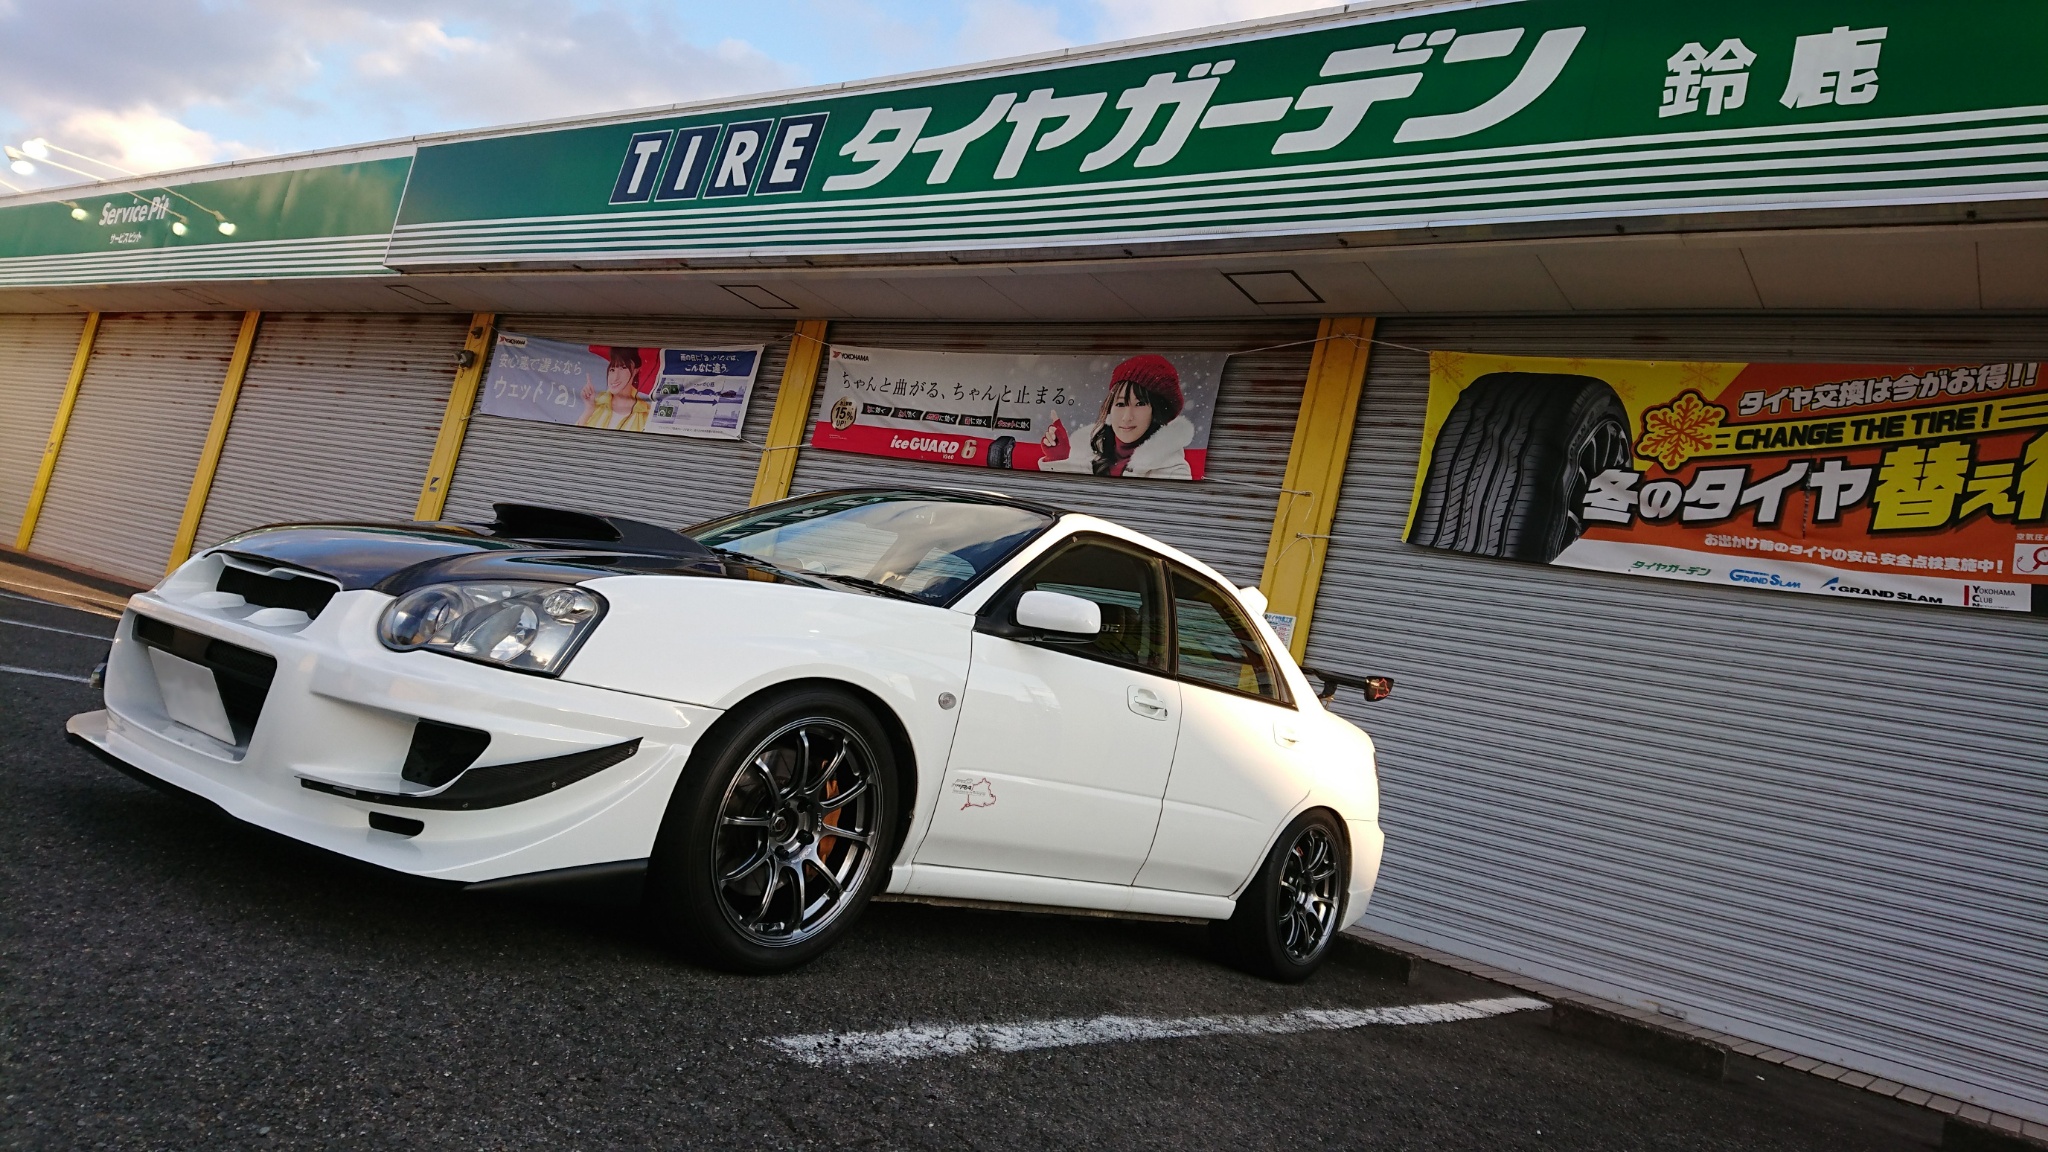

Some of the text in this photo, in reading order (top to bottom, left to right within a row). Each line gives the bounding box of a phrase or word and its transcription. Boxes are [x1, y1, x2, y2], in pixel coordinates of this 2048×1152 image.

[627, 25, 1889, 194] TIRE タイヤガーデン 鈴鹿
[98, 194, 170, 226] Service Pit
[498, 352, 582, 376] 安心感で選ぶなら
[684, 362, 729, 374] こんなに違う。
[841, 352, 870, 362] YOKOHAMA
[842, 371, 1076, 407] ちゃんと曲がる、ちゃんと止まる。
[1734, 421, 1847, 451] CHANGE
[1850, 414, 1908, 442] THE
[889, 435, 978, 460] iceGUARD 6
[1632, 560, 1712, 577] タイヤガーデン
[1729, 568, 1802, 590] GRAND SLAM
[1838, 585, 1944, 604] GRAND SLAM
[1972, 585, 2017, 597] YOKOHAMA
[1972, 594, 1994, 604] CLUB
